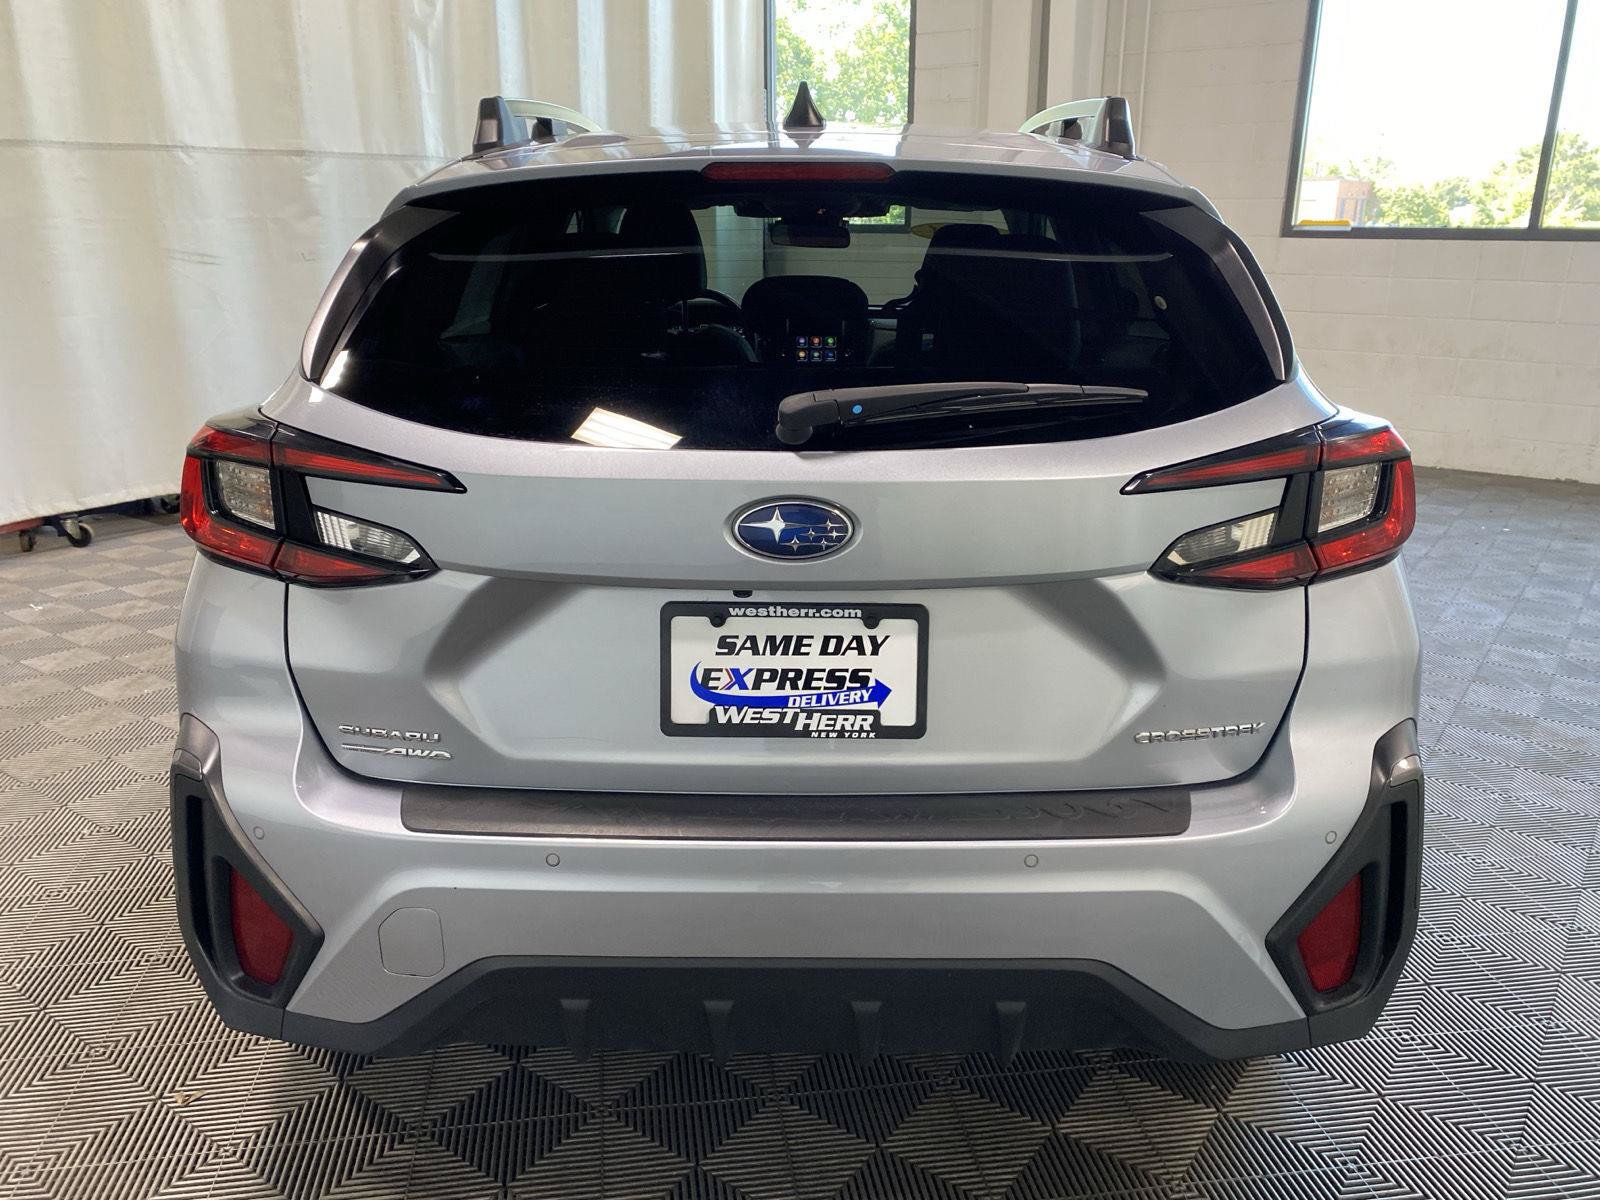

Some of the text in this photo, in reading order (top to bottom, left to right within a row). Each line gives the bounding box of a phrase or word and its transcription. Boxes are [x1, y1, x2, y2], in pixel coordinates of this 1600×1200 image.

[729, 606, 862, 617] westherr.com
[715, 635, 890, 656] SAME DAY
[700, 668, 872, 690] EXPRESS
[788, 690, 872, 708] DELIVERY
[338, 724, 441, 742] SUBARU
[1134, 722, 1266, 744] CROSSTREK
[384, 747, 453, 760] AWD
